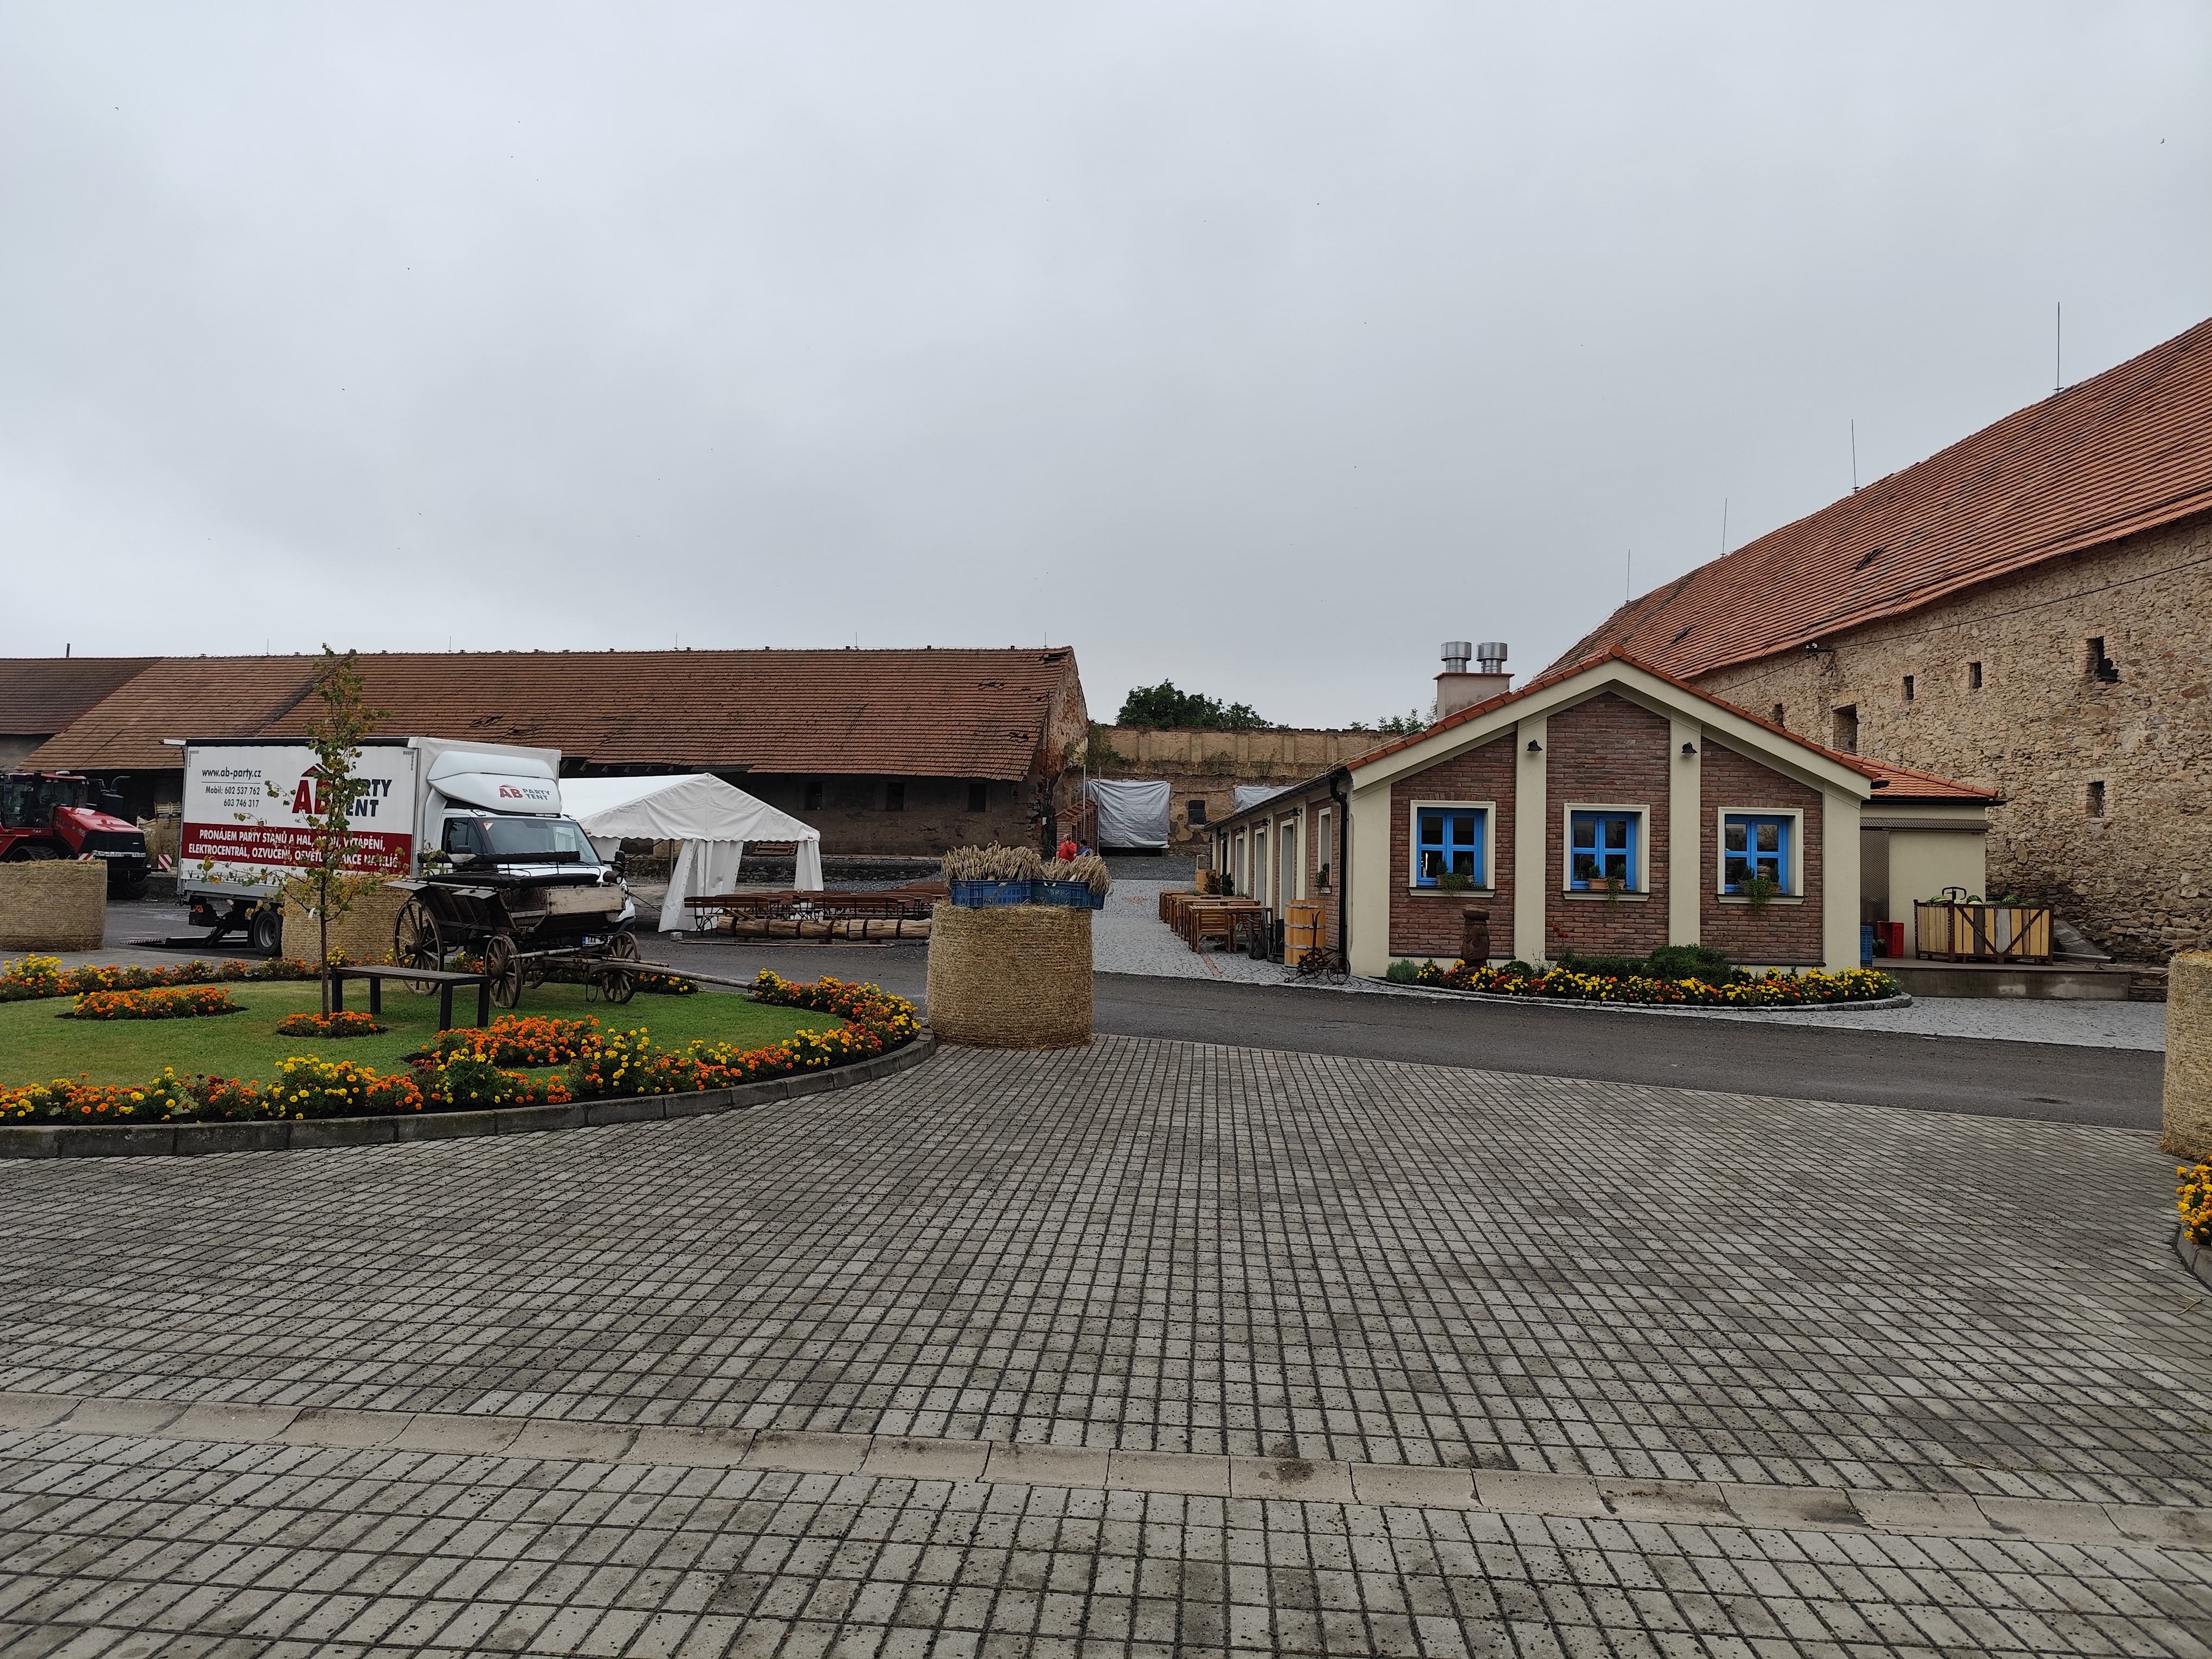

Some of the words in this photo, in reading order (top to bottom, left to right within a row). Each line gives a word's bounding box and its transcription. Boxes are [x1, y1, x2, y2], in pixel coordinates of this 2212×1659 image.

[202, 767, 261, 780] www.ab-party.cz
[205, 786, 223, 794] Mobil:
[224, 787, 235, 795] 602
[237, 787, 248, 795] 537
[249, 787, 260, 795] 762
[499, 788, 523, 798] AB
[236, 799, 247, 807] 746
[248, 800, 259, 808] 317
[343, 799, 379, 817] ENT
[200, 827, 237, 841] PRONÁJEM
[239, 831, 261, 842] PARTY
[262, 831, 287, 844] STANŮ
[288, 834, 294, 844] A
[297, 834, 314, 847] HAL,
[189, 843, 250, 859] ELEKTROCENTRÁL,
